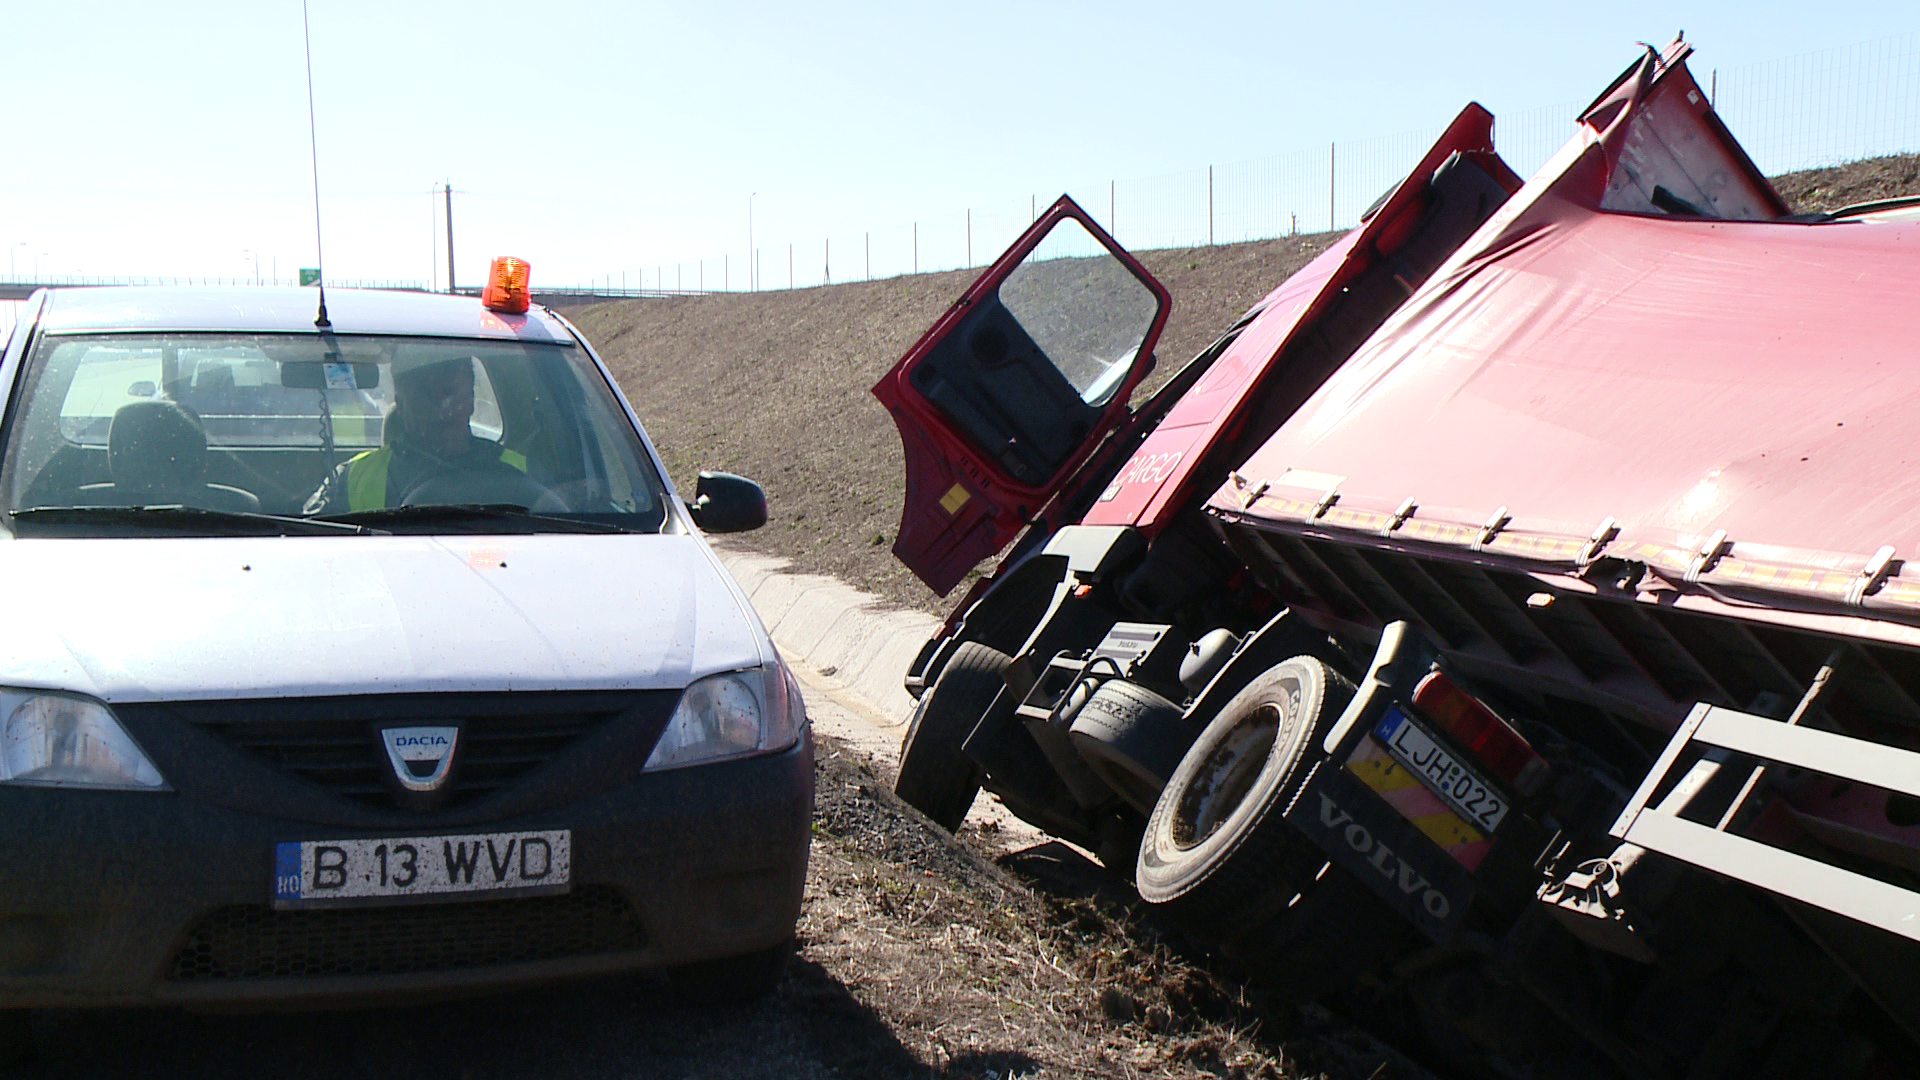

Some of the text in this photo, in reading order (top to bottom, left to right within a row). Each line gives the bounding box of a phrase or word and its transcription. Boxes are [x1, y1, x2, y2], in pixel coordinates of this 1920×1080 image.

[1113, 451, 1183, 484] CARGO
[395, 735, 449, 747] DACIA
[312, 837, 552, 890] B 13 WVD
[1318, 791, 1450, 918] VOLVO
